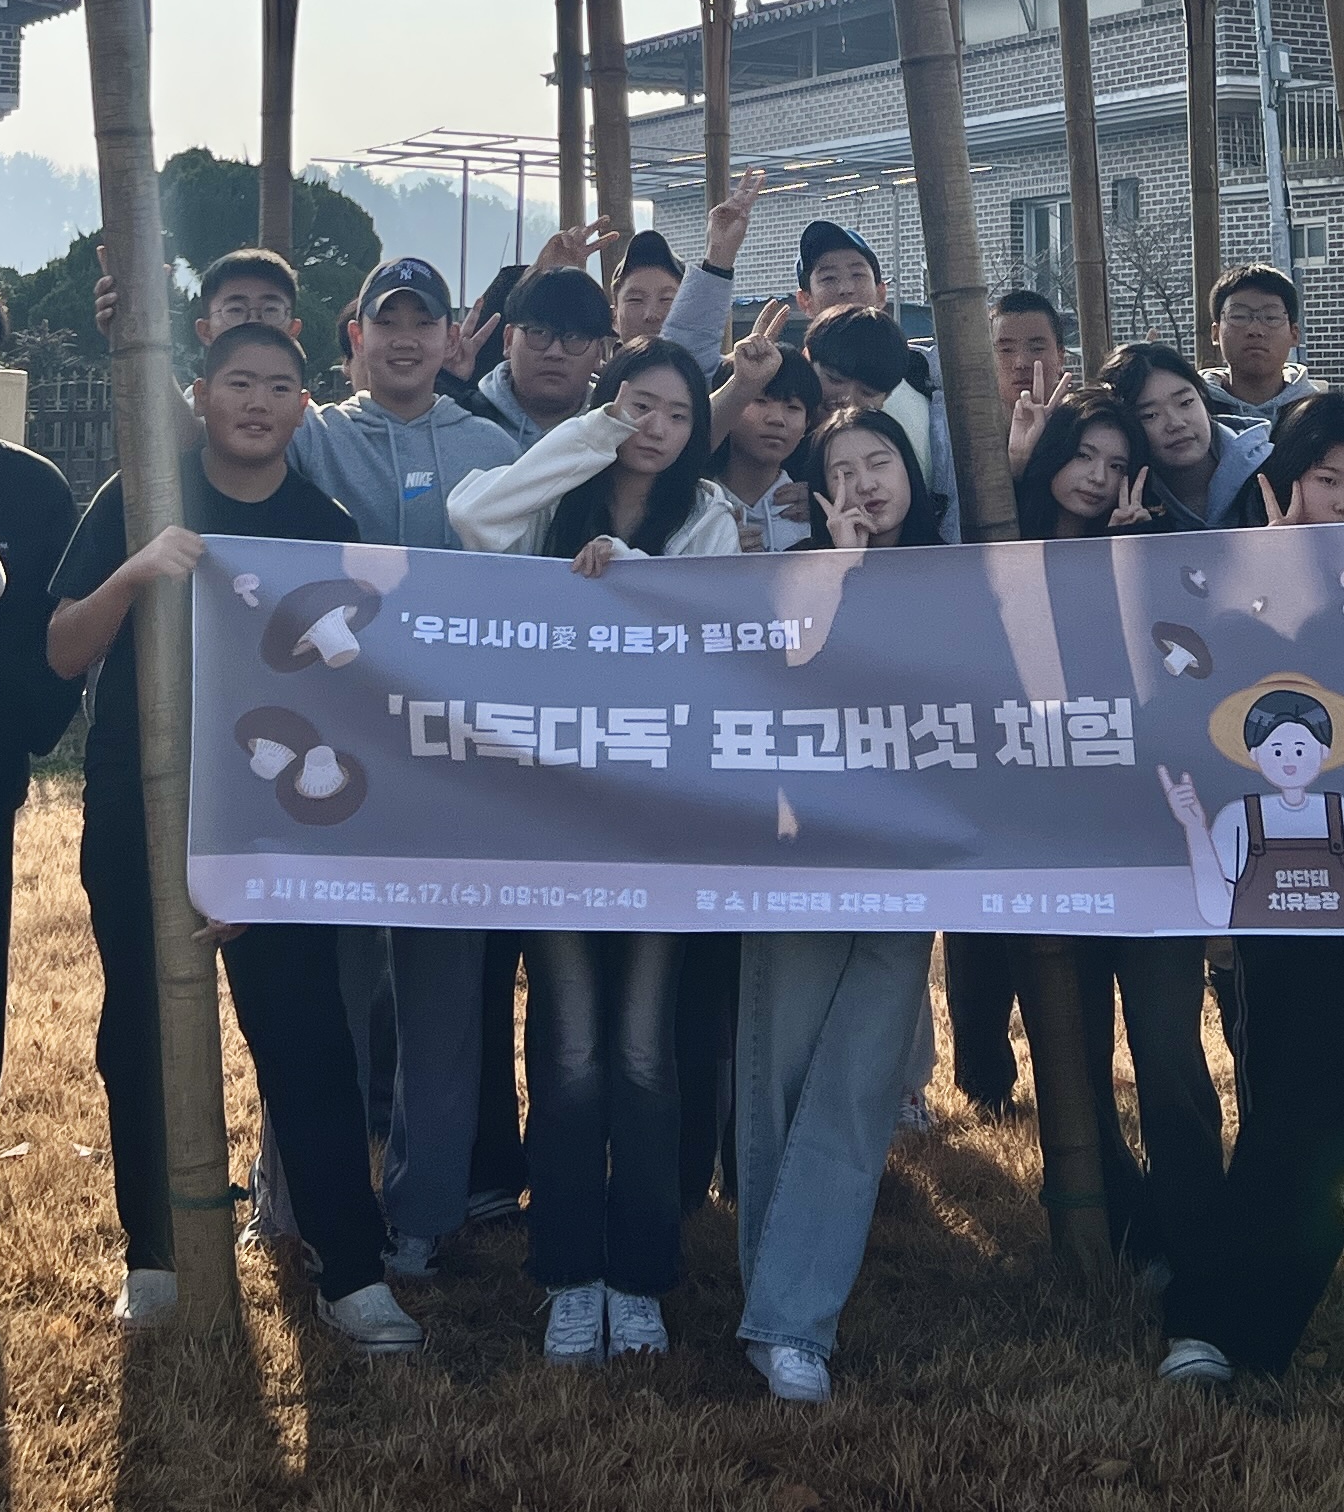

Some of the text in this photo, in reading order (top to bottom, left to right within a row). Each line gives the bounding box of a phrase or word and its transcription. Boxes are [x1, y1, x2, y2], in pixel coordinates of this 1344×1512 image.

[405, 472, 434, 488] NIKE
[588, 624, 688, 653] 위로가
[388, 694, 1136, 771] '다독다독' 표고버섯 체험
[1275, 869, 1329, 888] 안단테
[767, 892, 831, 911] 안단테
[839, 892, 928, 912] 치유농장
[1055, 893, 1115, 914] 2학년
[1268, 891, 1340, 911] 치유농장
